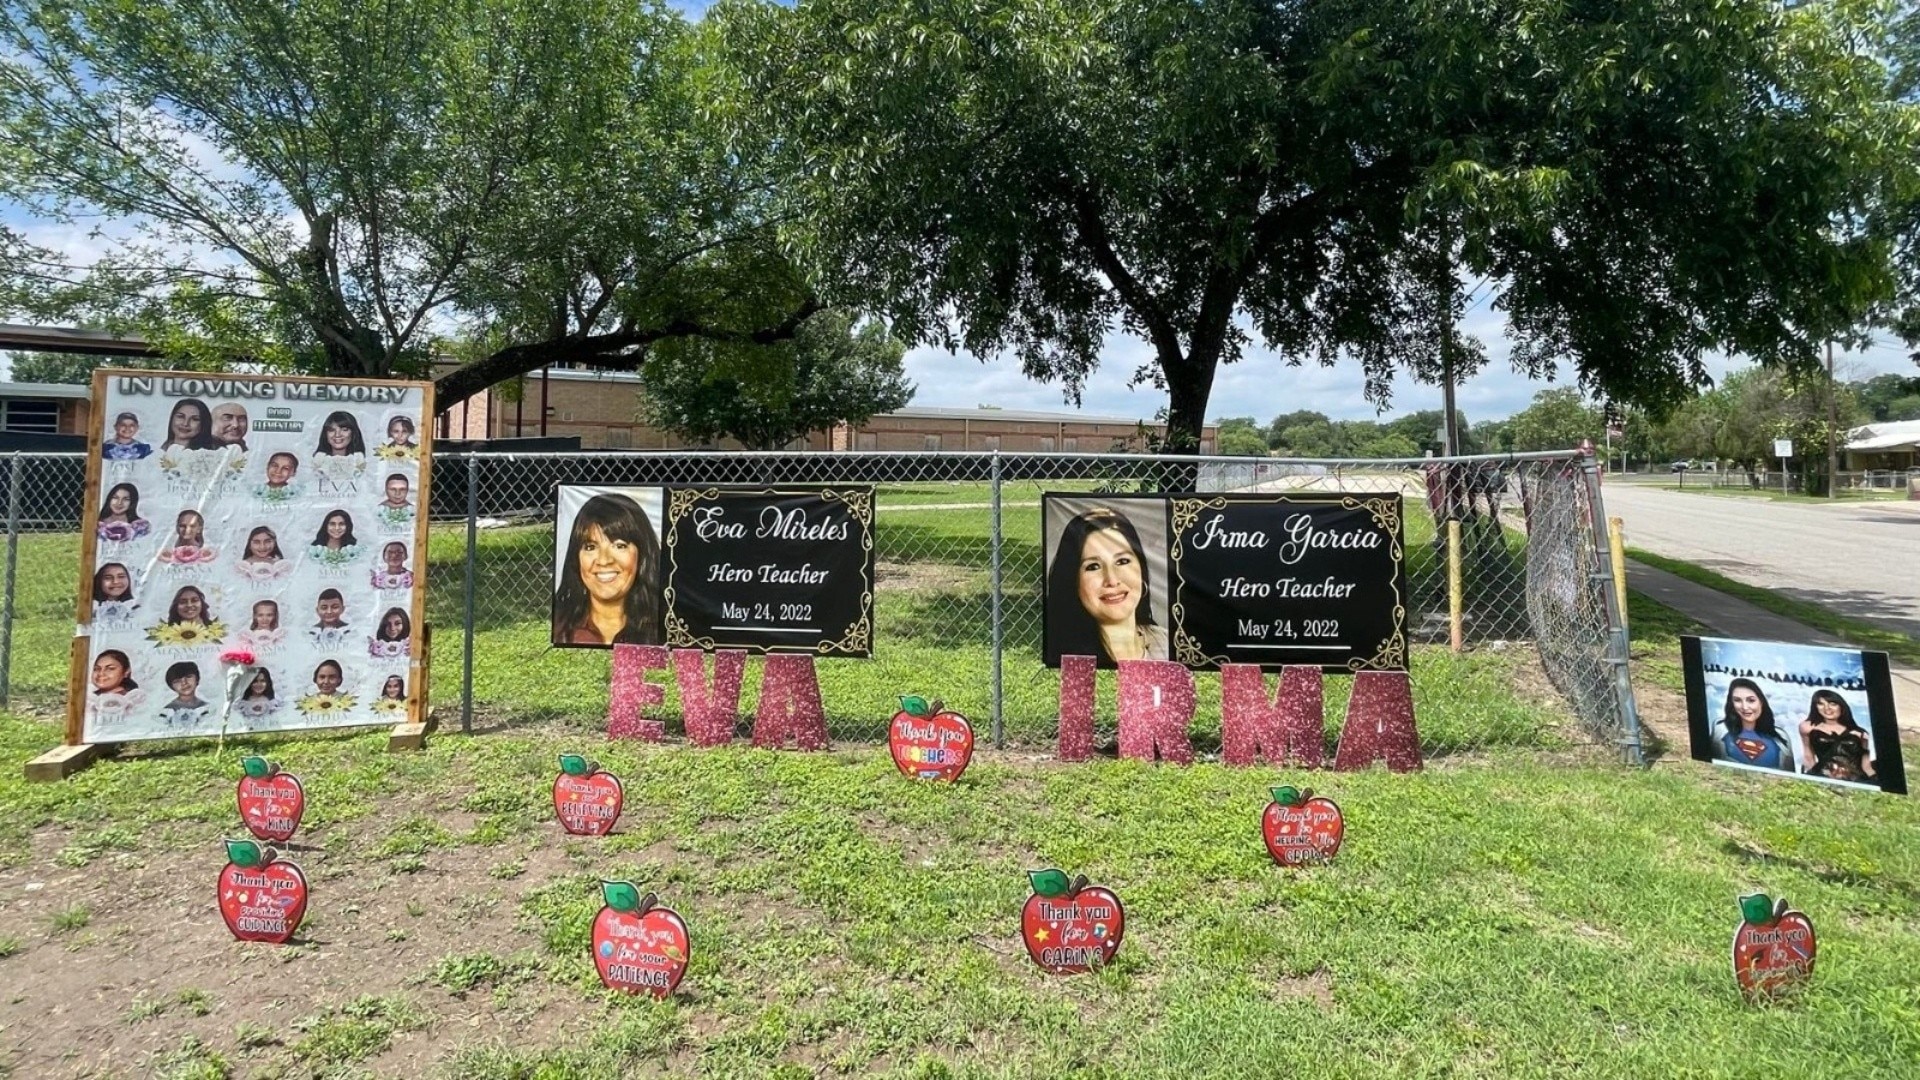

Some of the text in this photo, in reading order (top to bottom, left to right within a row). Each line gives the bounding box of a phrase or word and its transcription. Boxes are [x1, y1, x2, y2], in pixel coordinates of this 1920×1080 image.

[119, 377, 408, 403] IN LOVING MEMORY
[252, 420, 304, 432] ELEMENTARY
[318, 478, 358, 493] EVA
[693, 505, 849, 543] Eva Mireles
[1192, 513, 1383, 565] Irma Garcia
[707, 563, 829, 584] Hero Teacher
[1219, 576, 1356, 598] Hero Teacher
[722, 602, 812, 622] May 24, 2022
[1237, 619, 1339, 638] May 24, 2022
[608, 643, 829, 752] EVA
[1059, 654, 1424, 773] IRMA
[896, 721, 966, 749] Thank you
[250, 782, 296, 802] Thank you
[559, 779, 594, 793] Thank
[1270, 807, 1337, 827] Thank you
[1274, 835, 1312, 847] HELPING
[231, 870, 297, 895] Thank you
[254, 890, 276, 907] for
[1038, 901, 1112, 925] Thank you
[607, 916, 675, 948] Thank you
[1060, 920, 1089, 946] for
[1745, 928, 1807, 948] Thank you
[616, 943, 668, 964] for your
[1769, 943, 1788, 966] for
